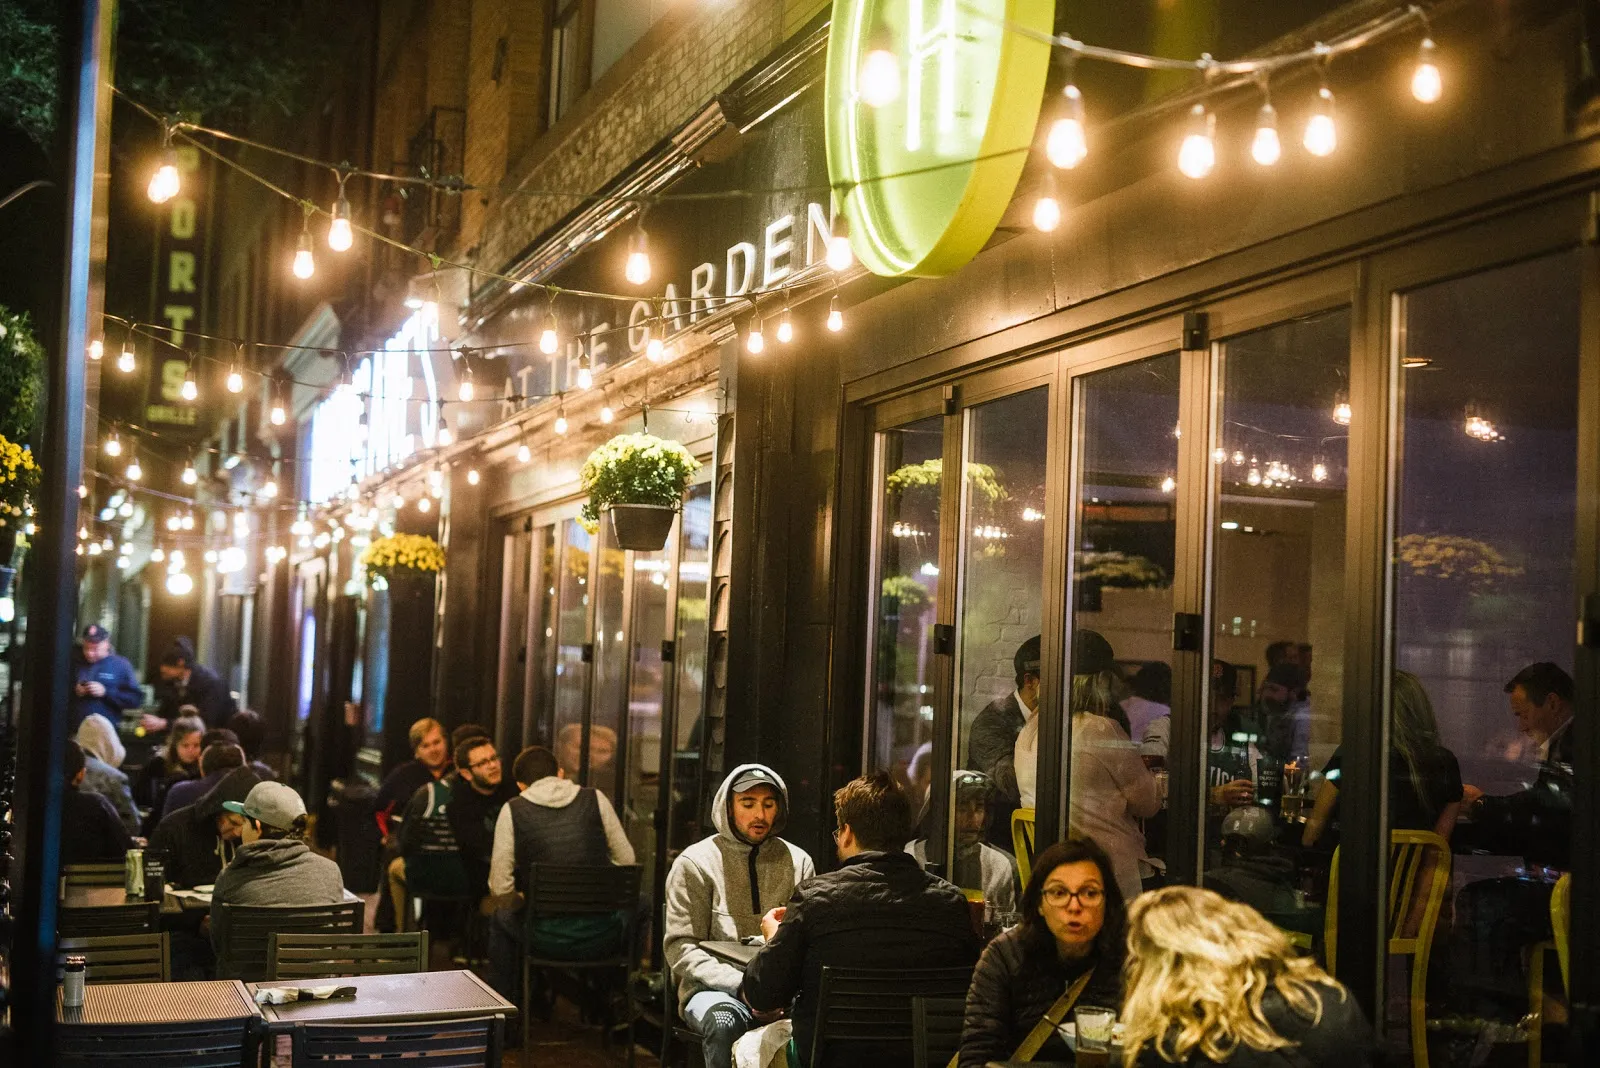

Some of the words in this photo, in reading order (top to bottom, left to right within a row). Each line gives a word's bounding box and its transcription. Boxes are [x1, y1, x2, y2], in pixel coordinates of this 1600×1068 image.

[500, 366, 533, 420] AT
[544, 322, 609, 396] THE
[628, 190, 838, 353] GARDEN
